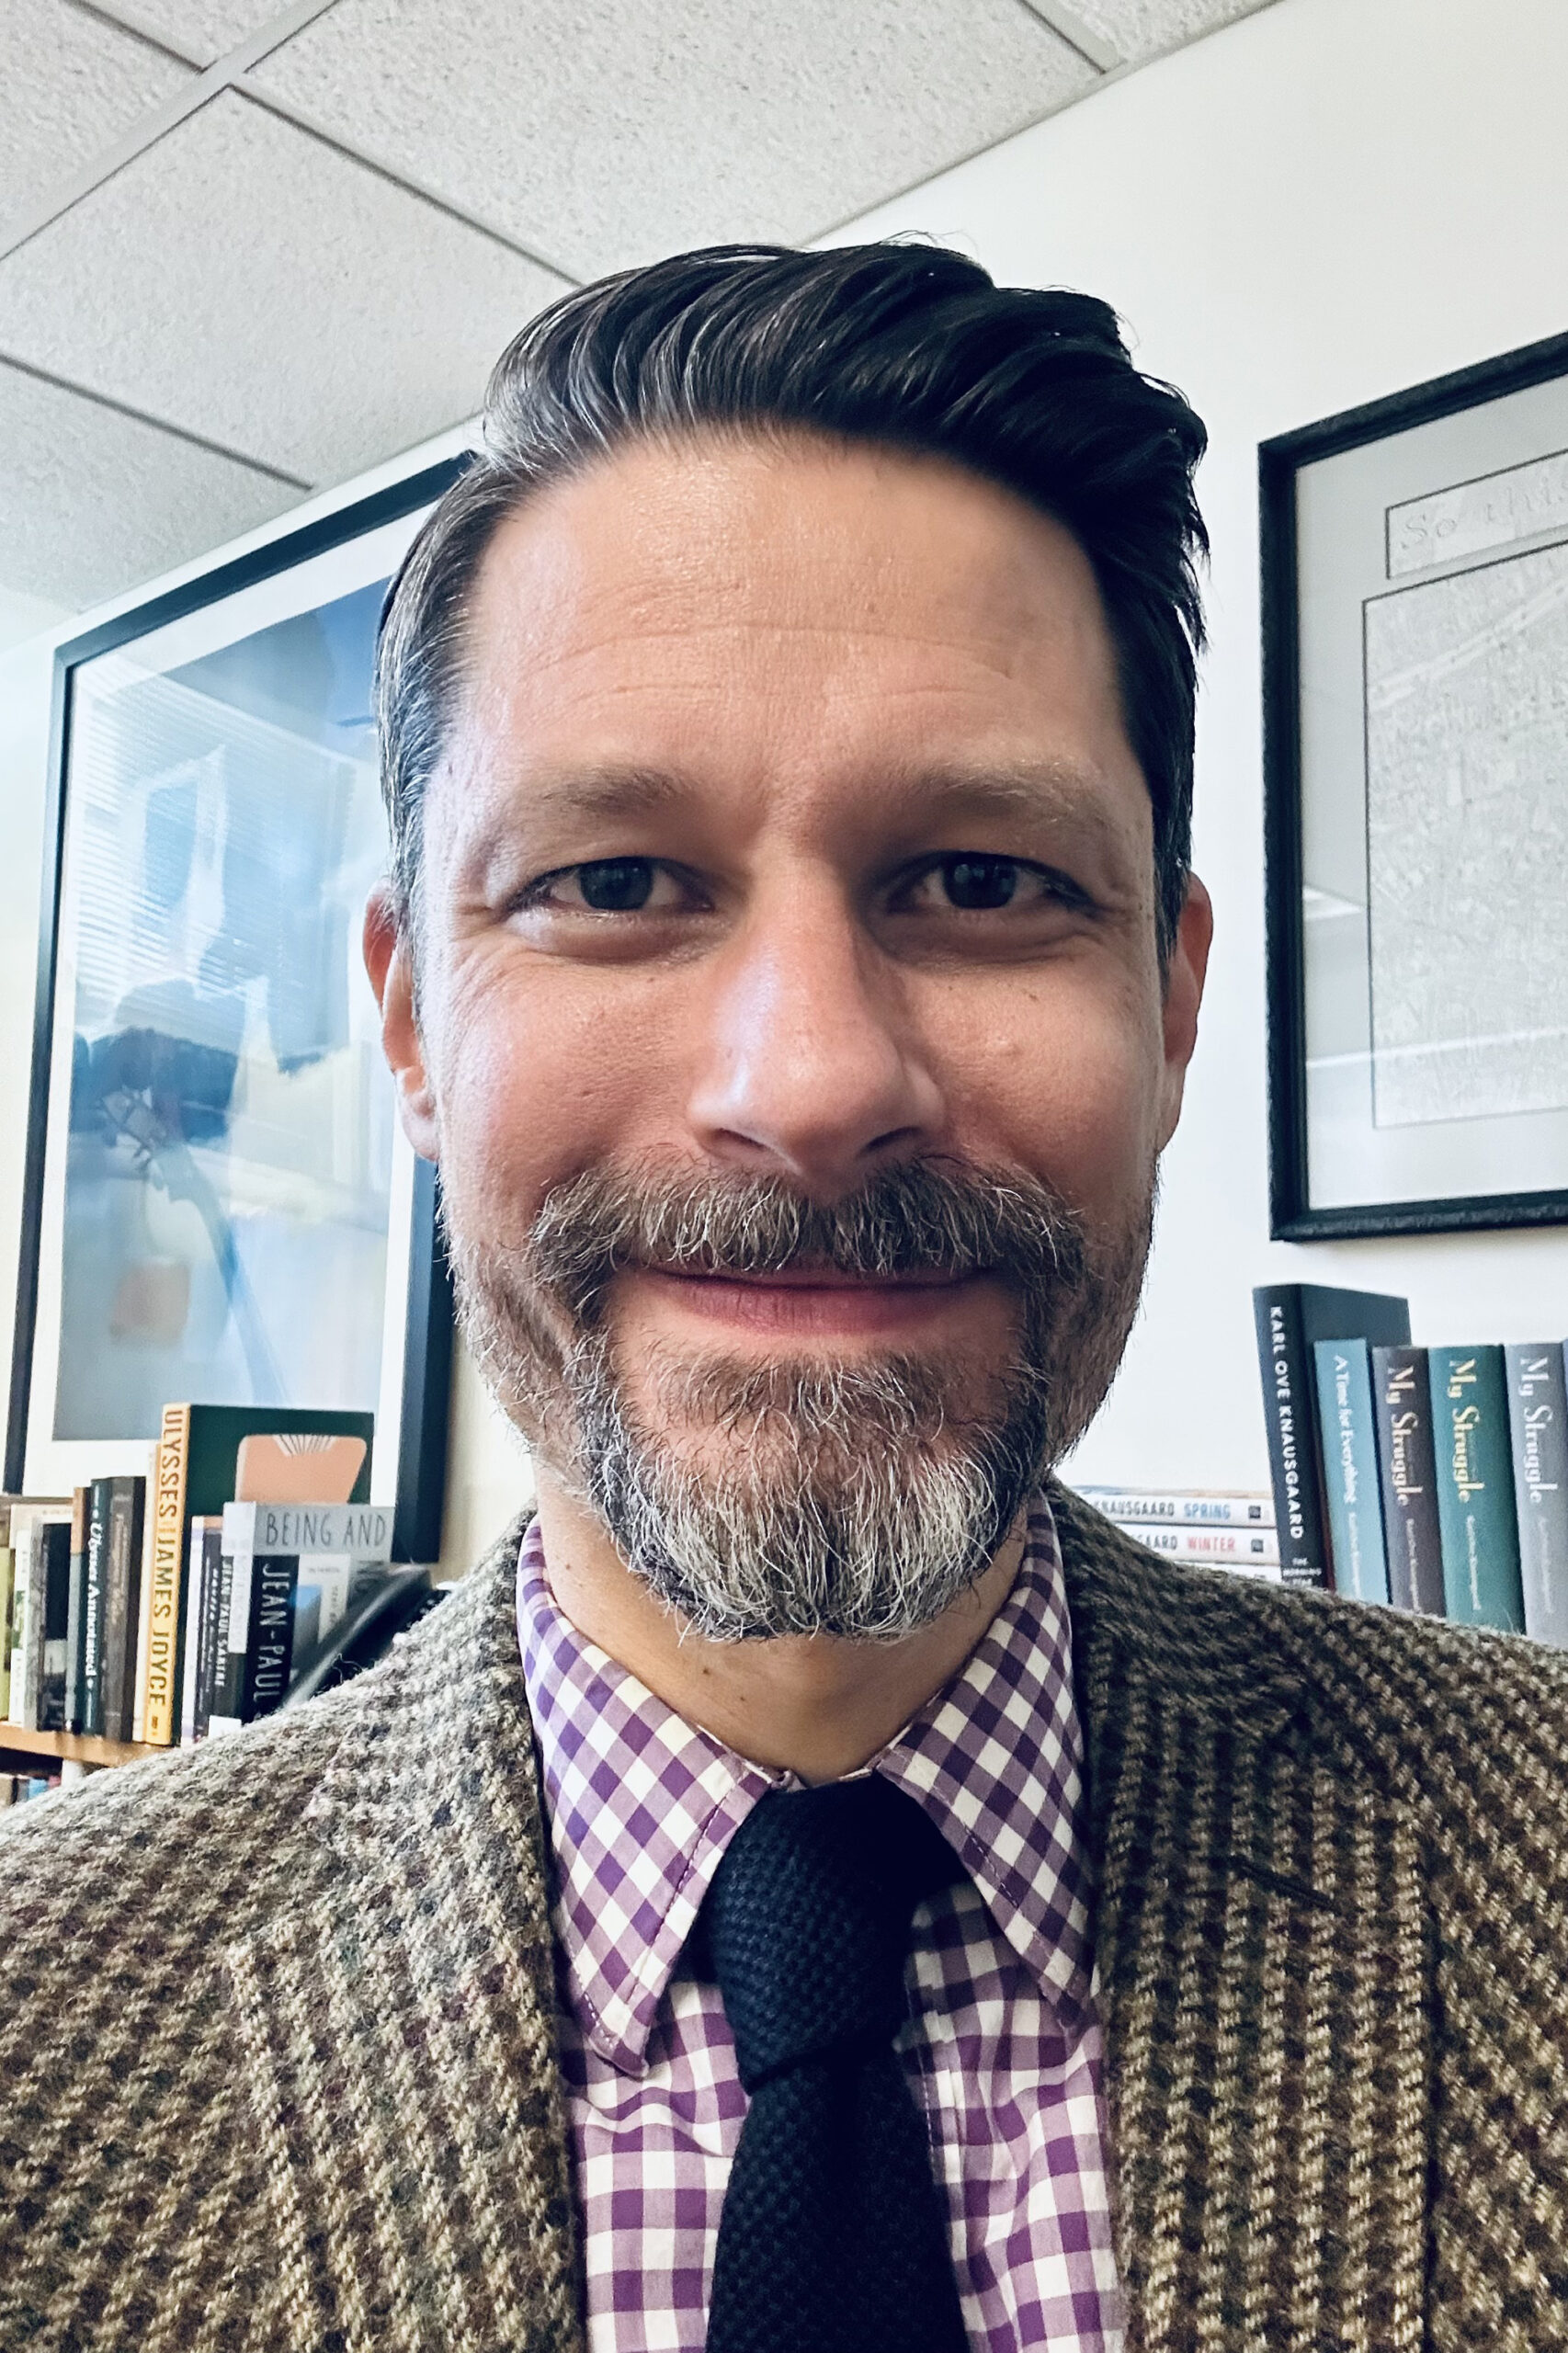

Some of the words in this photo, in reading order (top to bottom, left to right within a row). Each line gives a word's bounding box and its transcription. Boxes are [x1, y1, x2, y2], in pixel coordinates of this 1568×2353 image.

[1270, 1306, 1285, 1352] KARL
[1275, 1359, 1290, 1400] OVE
[1335, 1355, 1348, 1370] A
[1385, 1365, 1415, 1405] My
[1447, 1358, 1477, 1399] My
[1518, 1357, 1550, 1397] My
[159, 1408, 183, 1518] ULYSSES
[1278, 1405, 1305, 1540] KNAUSGAARD
[1391, 1411, 1424, 1507] Struggle
[1452, 1405, 1485, 1504] Struggle
[1523, 1404, 1559, 1505] Struggle
[265, 1512, 333, 1547] BEING
[343, 1515, 387, 1547] AND
[1183, 1502, 1232, 1520] SPRING
[1187, 1535, 1236, 1553] WINTER
[153, 1536, 176, 1619] JAMES
[85, 1583, 101, 1677] Annotated
[253, 1563, 290, 1705] JEAN-PAUL
[149, 1631, 168, 1706] JOYCE
[213, 1639, 229, 1688] SARTRE
